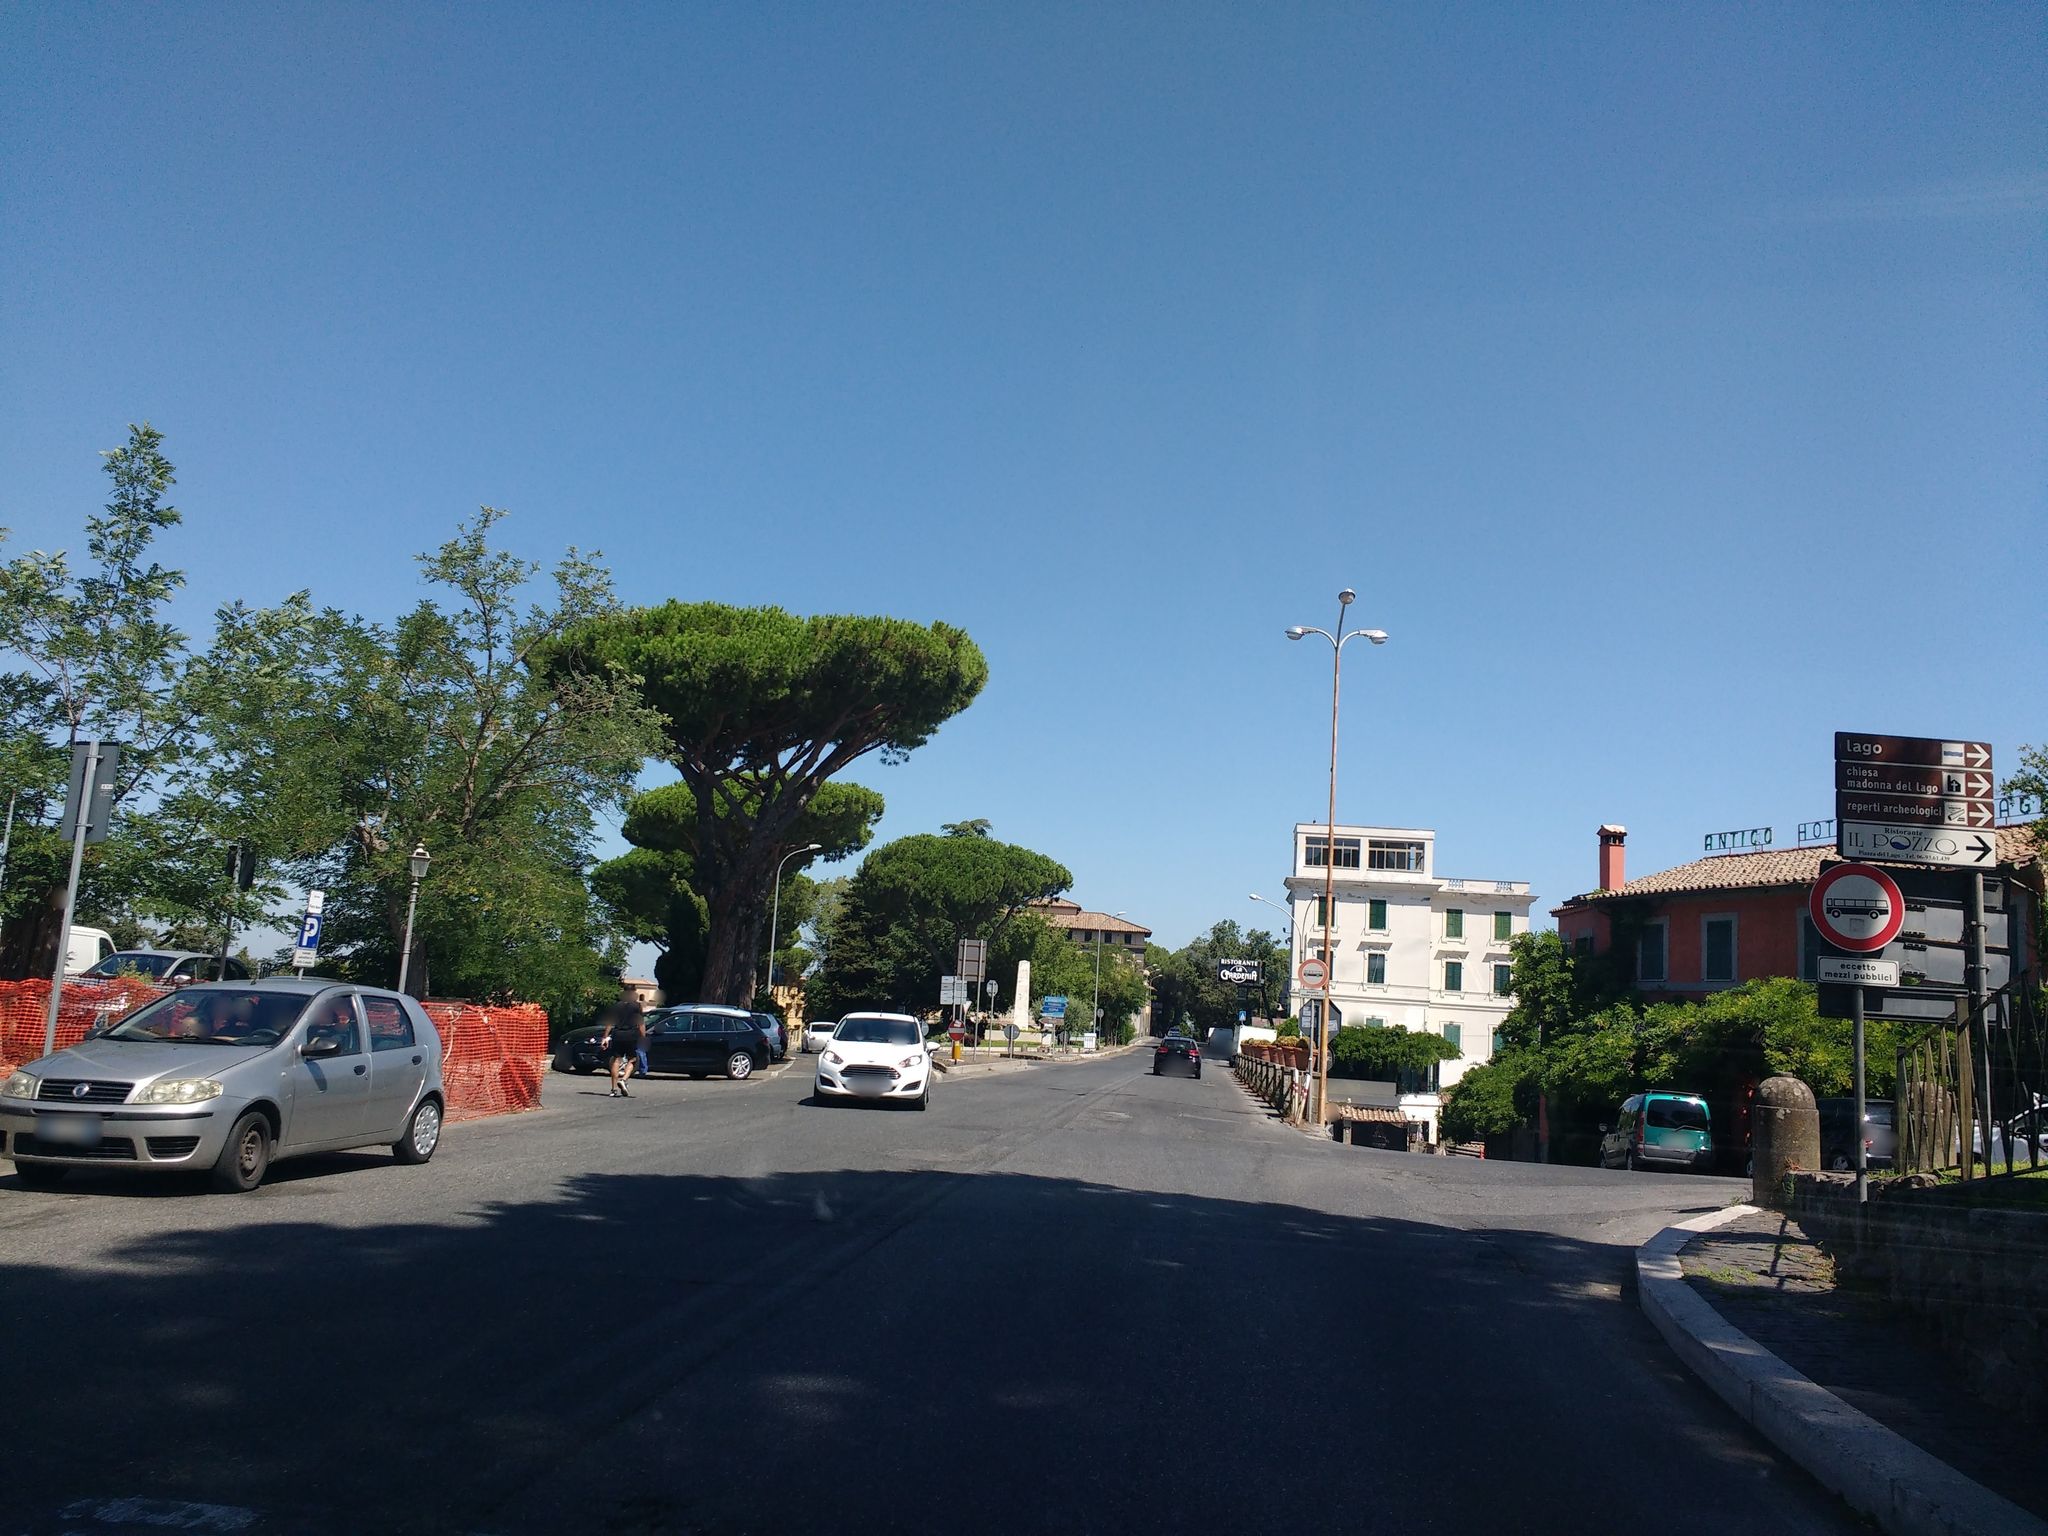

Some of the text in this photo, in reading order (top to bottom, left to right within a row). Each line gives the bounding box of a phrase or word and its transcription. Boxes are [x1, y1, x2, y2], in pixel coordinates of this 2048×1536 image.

[1847, 740, 1882, 755] lago
[1847, 766, 1879, 777] chiesa
[1848, 779, 1938, 794] madonna del lago
[1848, 802, 1942, 818] reperti archeologici
[1704, 827, 1772, 851] ANTICO
[1798, 820, 1834, 841] HOT
[1885, 828, 1923, 836] Ristorante
[1849, 832, 1959, 855] IL POZZO
[302, 917, 319, 946] P
[1221, 959, 1258, 967] RISTORANTE
[1840, 963, 1876, 971] eccetto
[1824, 971, 1892, 981] mezzi pubblici
